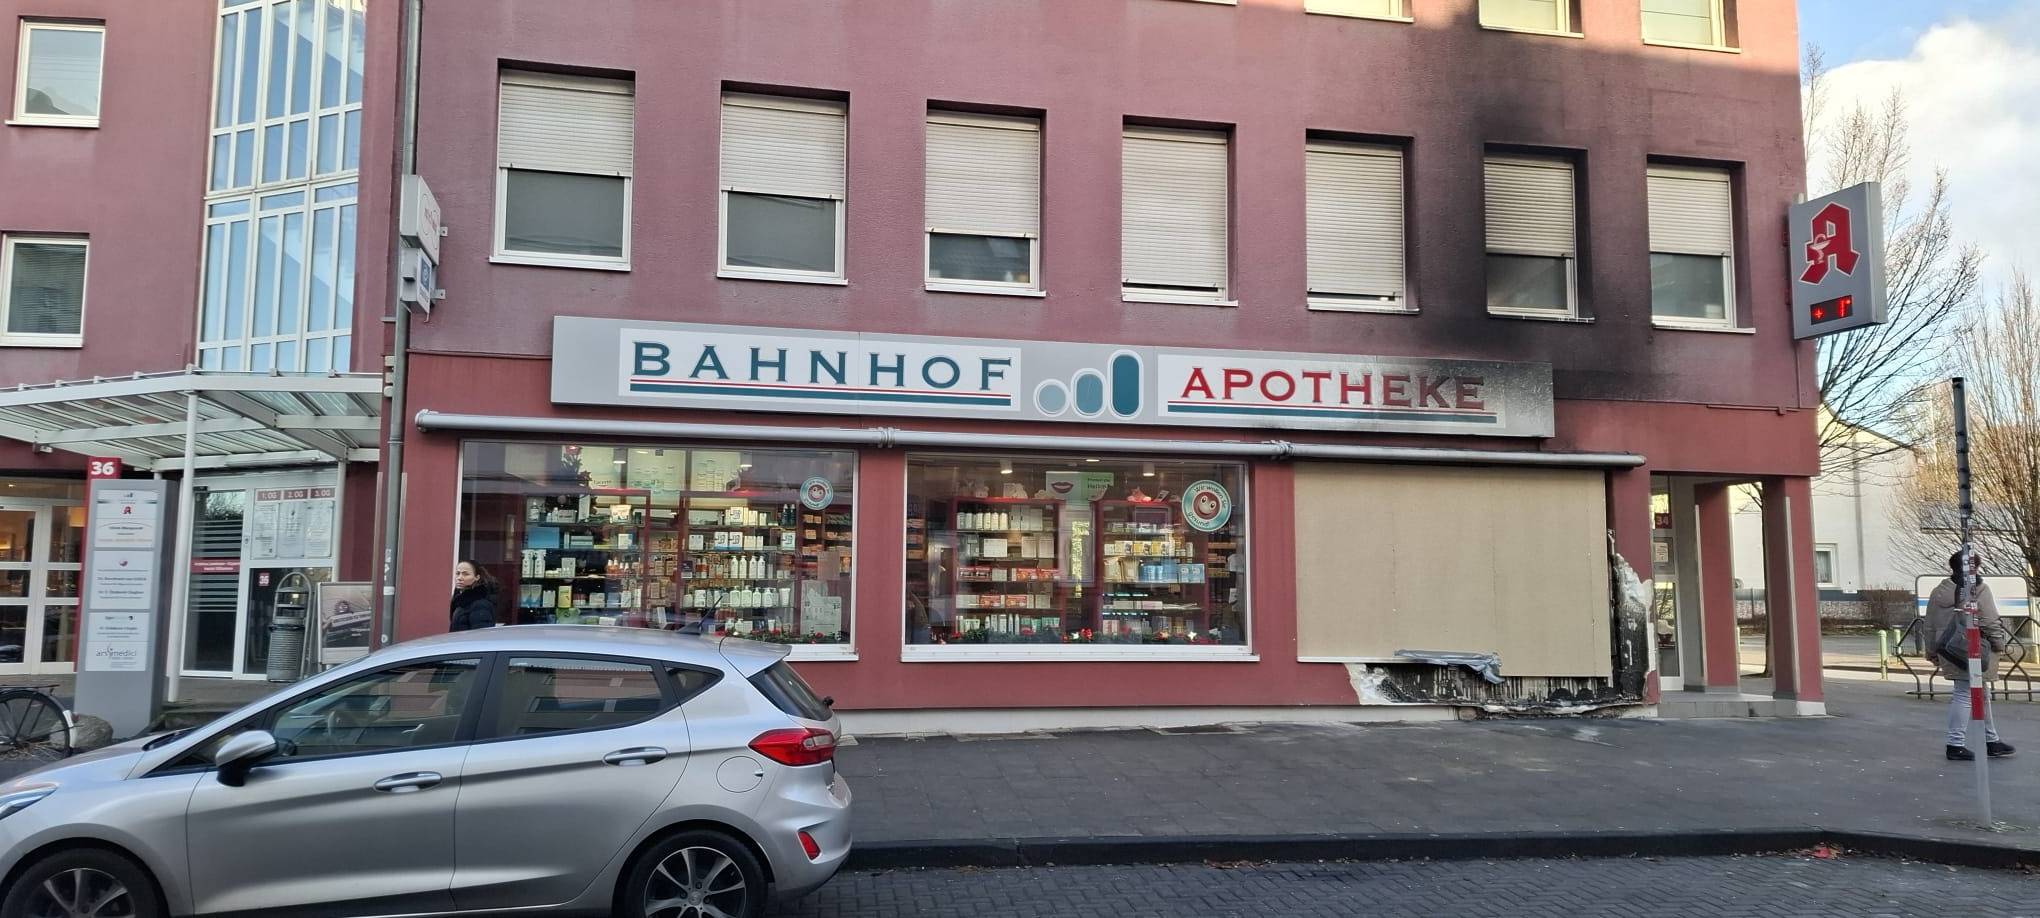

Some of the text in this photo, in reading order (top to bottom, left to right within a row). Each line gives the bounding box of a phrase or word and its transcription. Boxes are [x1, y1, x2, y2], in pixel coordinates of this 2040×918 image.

[632, 341, 1012, 390] BAHNHOF
[1181, 367, 1485, 410] APOTHEKE
[90, 461, 114, 476] 36
[1655, 516, 1669, 525] 34
